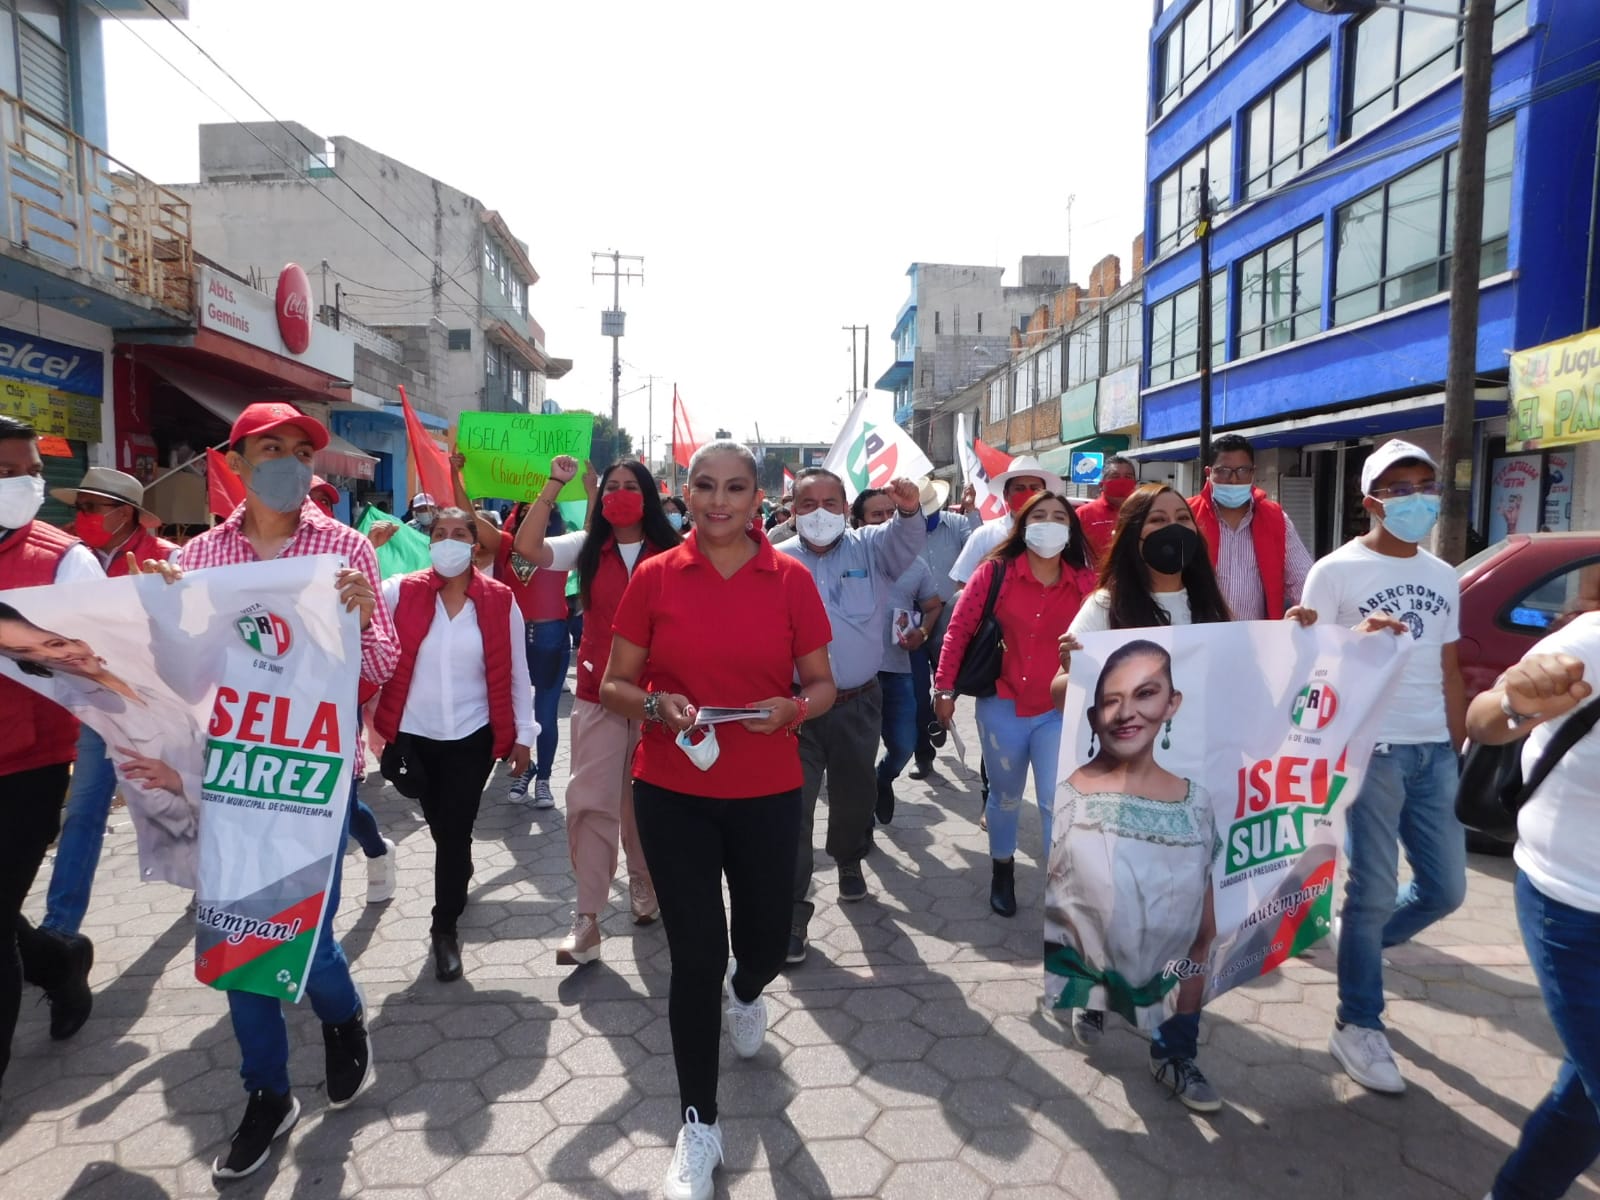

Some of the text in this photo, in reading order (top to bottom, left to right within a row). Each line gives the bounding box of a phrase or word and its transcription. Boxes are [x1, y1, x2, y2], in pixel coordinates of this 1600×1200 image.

[208, 279, 237, 304] Abts.
[208, 303, 250, 333] Geminis
[511, 416, 535, 430] con
[1517, 396, 1544, 441] EL
[468, 426, 584, 455] ISELA SUAREZ
[240, 603, 262, 614] VOTA
[1381, 598, 1441, 616] NY 1892
[239, 616, 286, 643] PRI
[253, 659, 258, 667] 6
[258, 661, 268, 670] DE
[1292, 689, 1332, 718] PRI
[226, 796, 266, 811] MUNICIPAL
[268, 801, 280, 811] DE
[279, 803, 333, 819] CHIAUTEMPAN
[1232, 804, 1305, 866] SUÁ
[1220, 873, 1248, 889] CANDIDATA
[1253, 860, 1289, 876] PRESIDENTA
